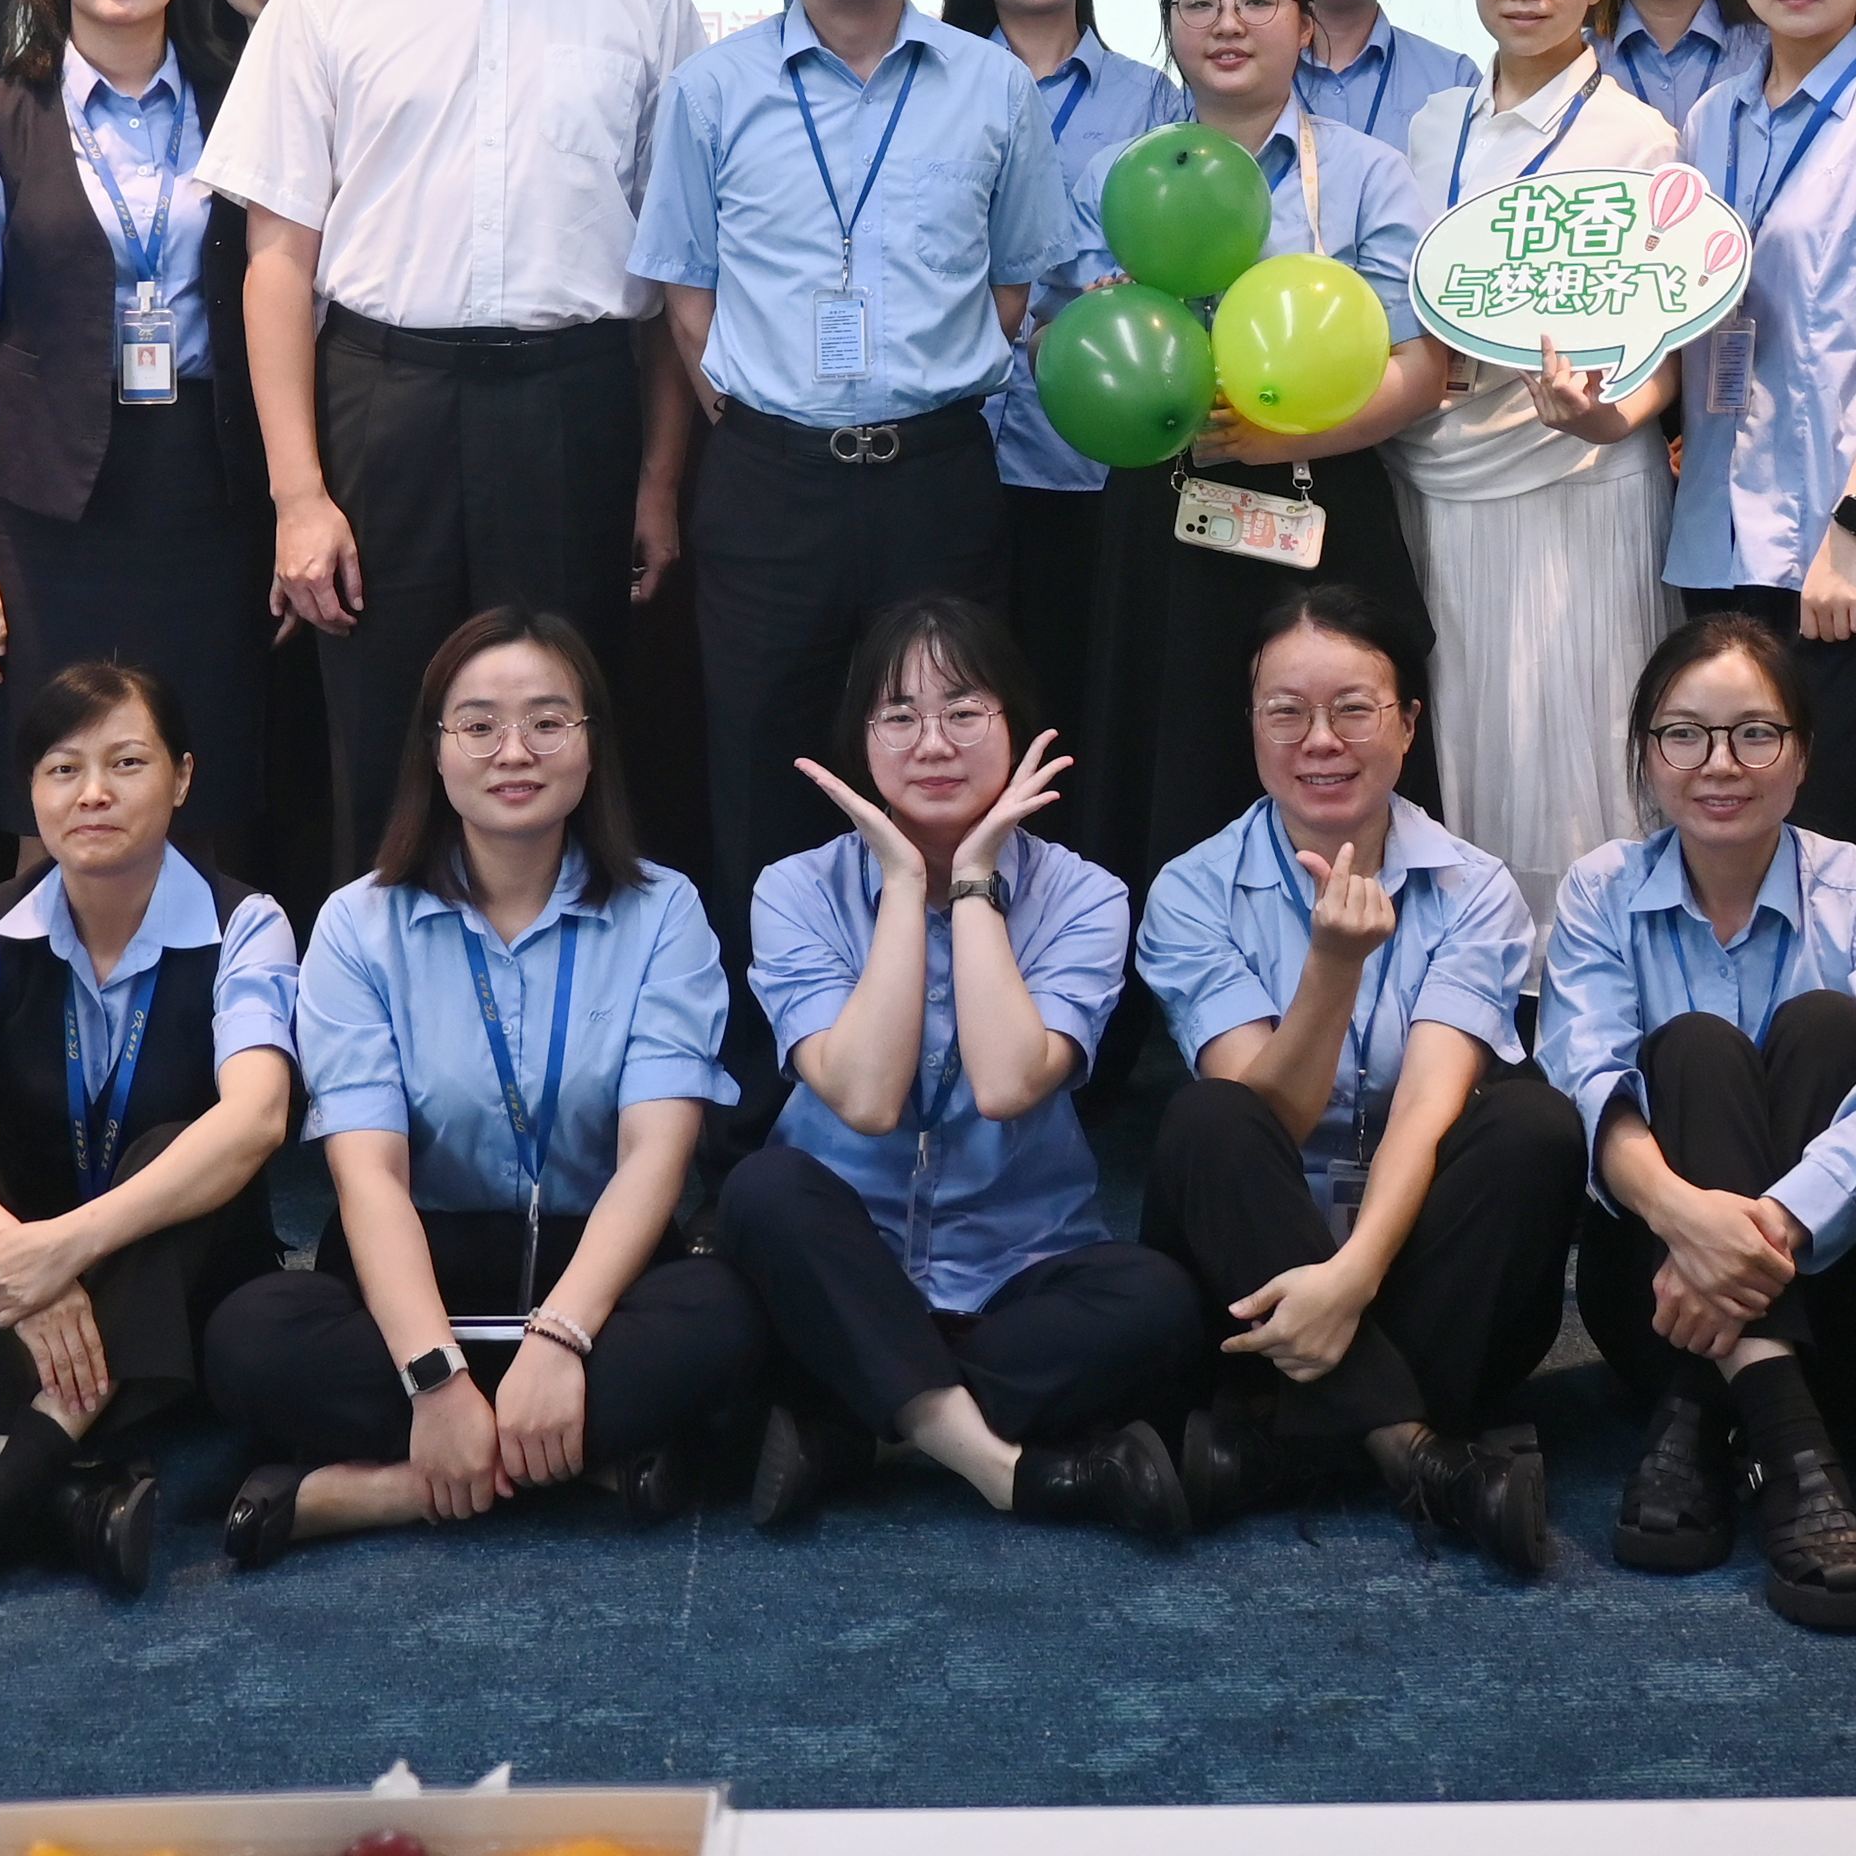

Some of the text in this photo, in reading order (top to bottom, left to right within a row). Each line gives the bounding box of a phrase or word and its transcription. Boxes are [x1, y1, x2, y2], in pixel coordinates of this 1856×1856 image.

[1491, 182, 1636, 260] 书香
[1439, 260, 1687, 317] 与梦想齐飞
